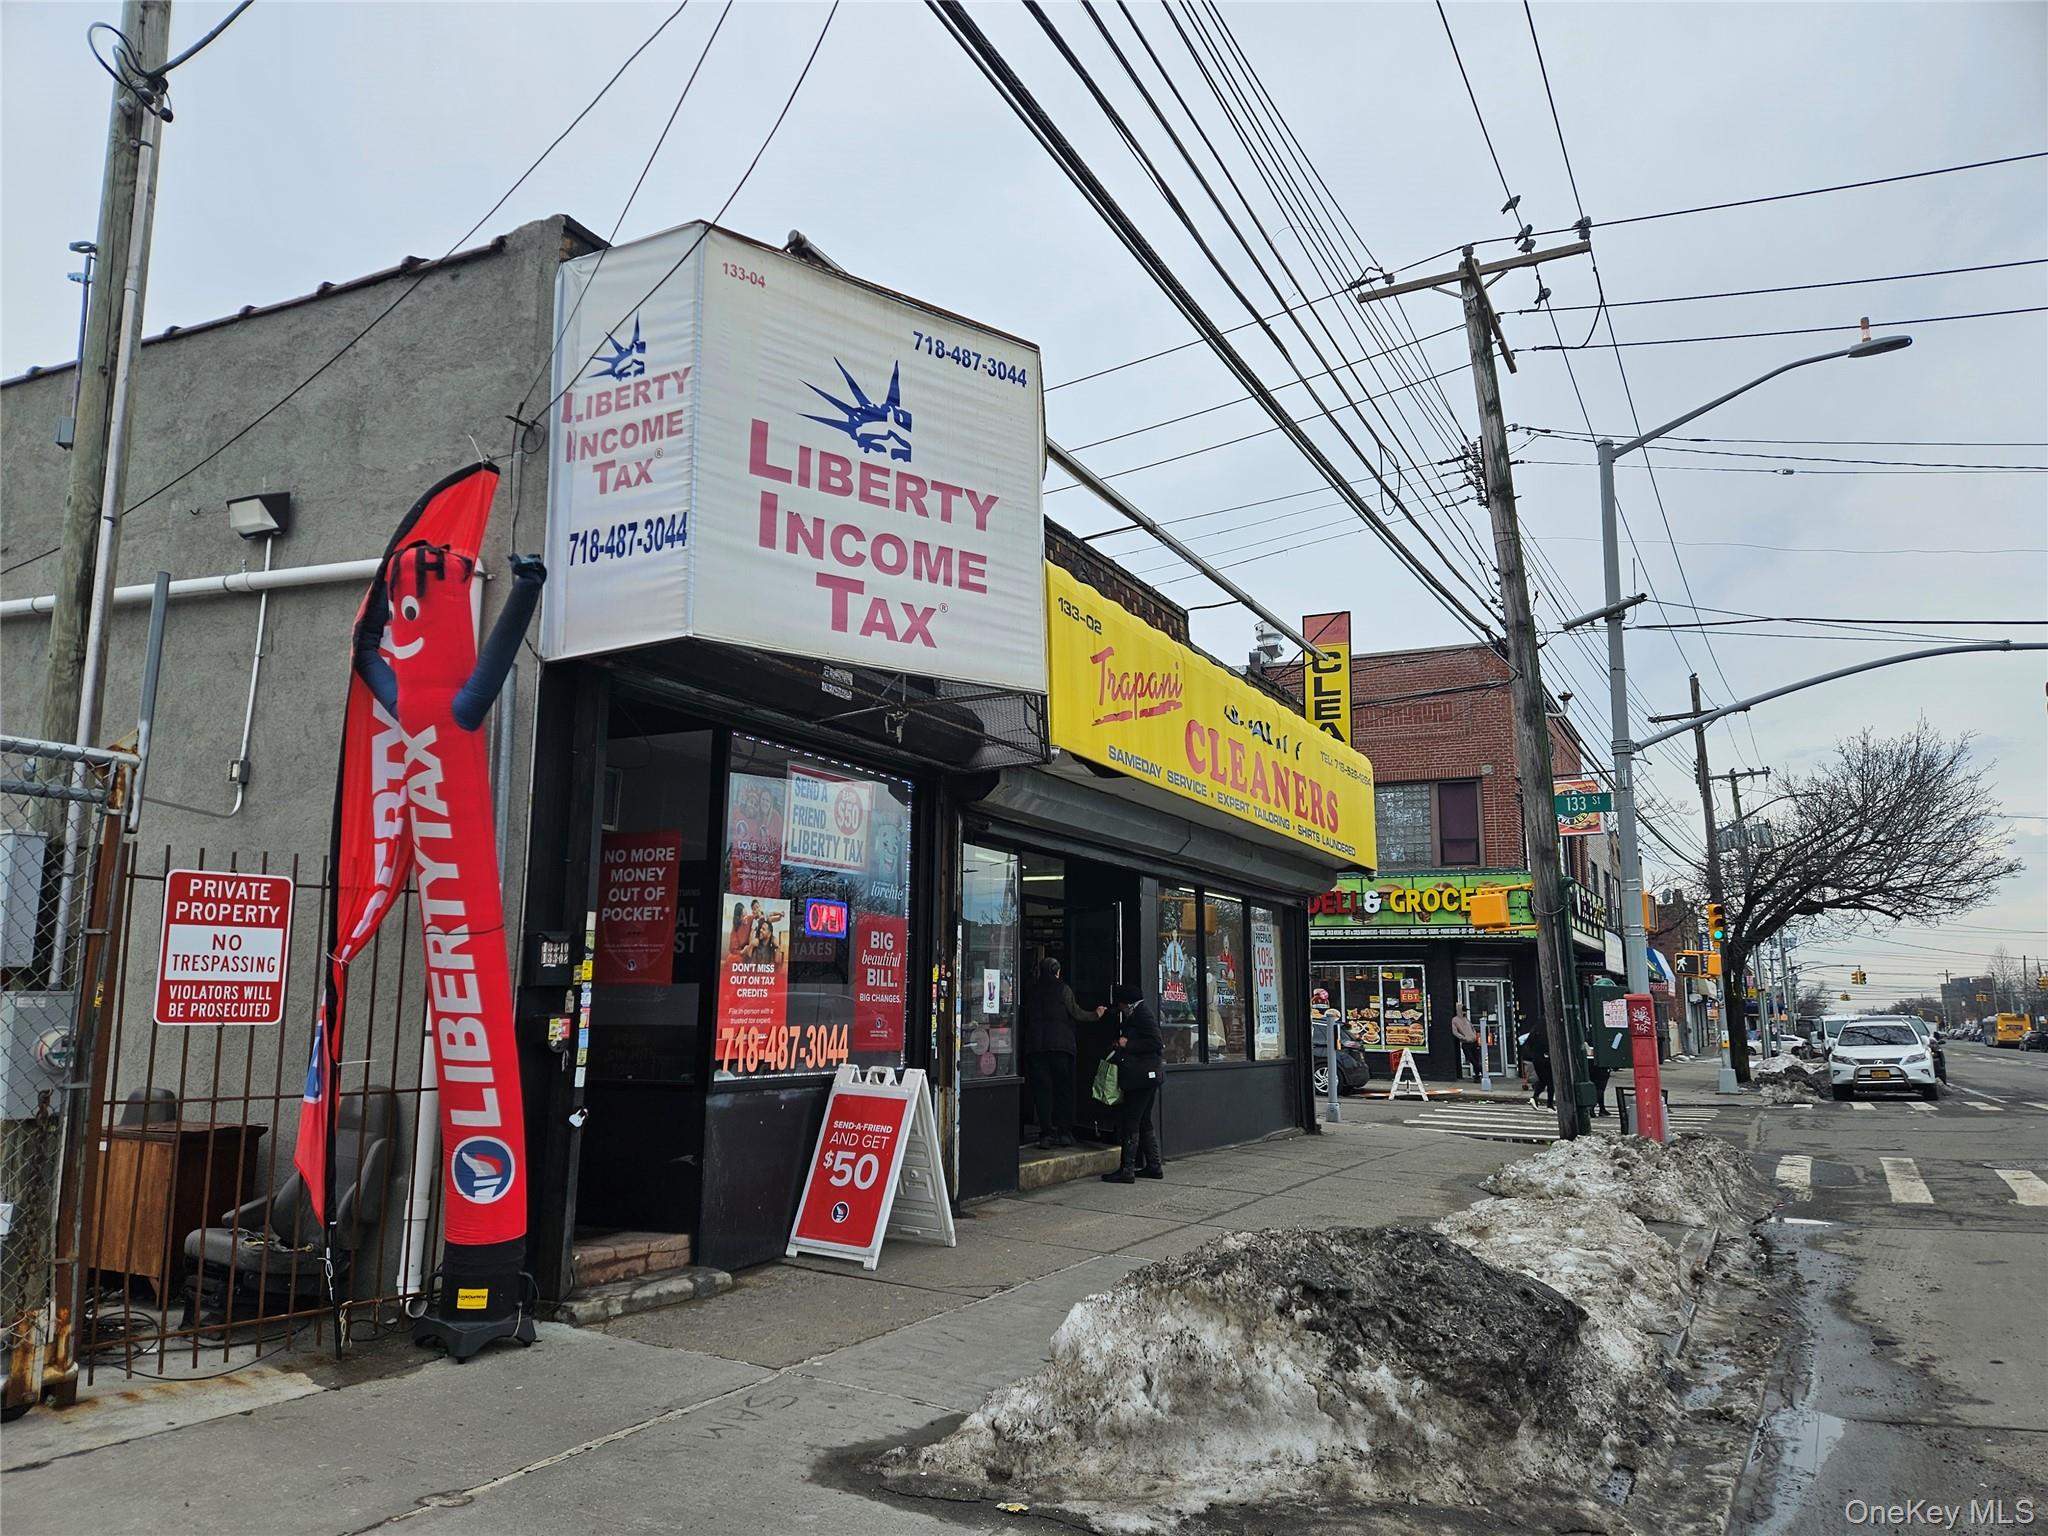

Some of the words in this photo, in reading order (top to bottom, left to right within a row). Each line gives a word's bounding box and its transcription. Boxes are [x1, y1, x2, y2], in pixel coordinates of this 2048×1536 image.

[722, 262, 766, 288] 133-04
[912, 330, 1027, 388] 718-487-3044
[561, 366, 692, 424] LIBERTY
[566, 409, 684, 463] INCOME
[749, 418, 1000, 532] LIBERTY
[569, 511, 688, 566] 718-487-3044
[758, 490, 988, 594] INCOME
[1058, 596, 1102, 635] 133-02
[1090, 646, 1183, 720] Trapani
[1184, 719, 1340, 834] CLEANERS
[794, 776, 819, 798] SEND
[821, 783, 828, 803] A
[1108, 745, 1162, 779] SAMEDAY
[1167, 770, 1207, 797] SERVICE
[1217, 791, 1250, 814] EXPERT
[1253, 806, 1290, 830] TAILORING
[1297, 824, 1321, 843] SHIRTS
[1322, 834, 1356, 857] LAUNDERED
[1566, 796, 1587, 811] 133
[1592, 796, 1601, 805] St
[792, 805, 827, 829] FRIEND
[837, 803, 860, 830] $50
[604, 850, 626, 863] NO
[630, 847, 675, 862] MORE
[790, 828, 840, 859] LIBERTY
[843, 837, 865, 864] TAX
[610, 867, 666, 882] MONEY
[189, 879, 271, 901] PRIVATE
[608, 887, 640, 901] OUT
[644, 886, 665, 901] OF
[1364, 890, 1381, 913] &
[1390, 887, 1508, 912] GROCE
[175, 901, 280, 923] PROPERTY
[809, 903, 846, 933] OPEN
[212, 934, 242, 950] NO
[870, 931, 894, 949] BIG
[172, 954, 276, 973] TRESPASSING
[861, 949, 902, 968] beautiful
[1257, 946, 1273, 967] 10%
[732, 963, 756, 972] DON'T
[757, 964, 775, 973] MISS
[866, 969, 898, 988] BILL.
[1259, 969, 1273, 988] OFF
[730, 976, 746, 985] OUT
[748, 976, 760, 985] ON
[761, 976, 775, 985] TAX
[169, 985, 239, 1000] VIOLATORS
[243, 986, 272, 1000] WILL
[736, 988, 768, 998] CREDITS
[859, 993, 870, 1002] BIG
[871, 993, 902, 1003] CHANGES.
[168, 1003, 185, 1017] BE
[190, 1003, 270, 1017] PROSECUTED
[721, 1024, 849, 1073] 718-487-3044
[829, 1131, 859, 1146] AND
[861, 1134, 890, 1150] GET
[823, 1150, 880, 1190] $50
